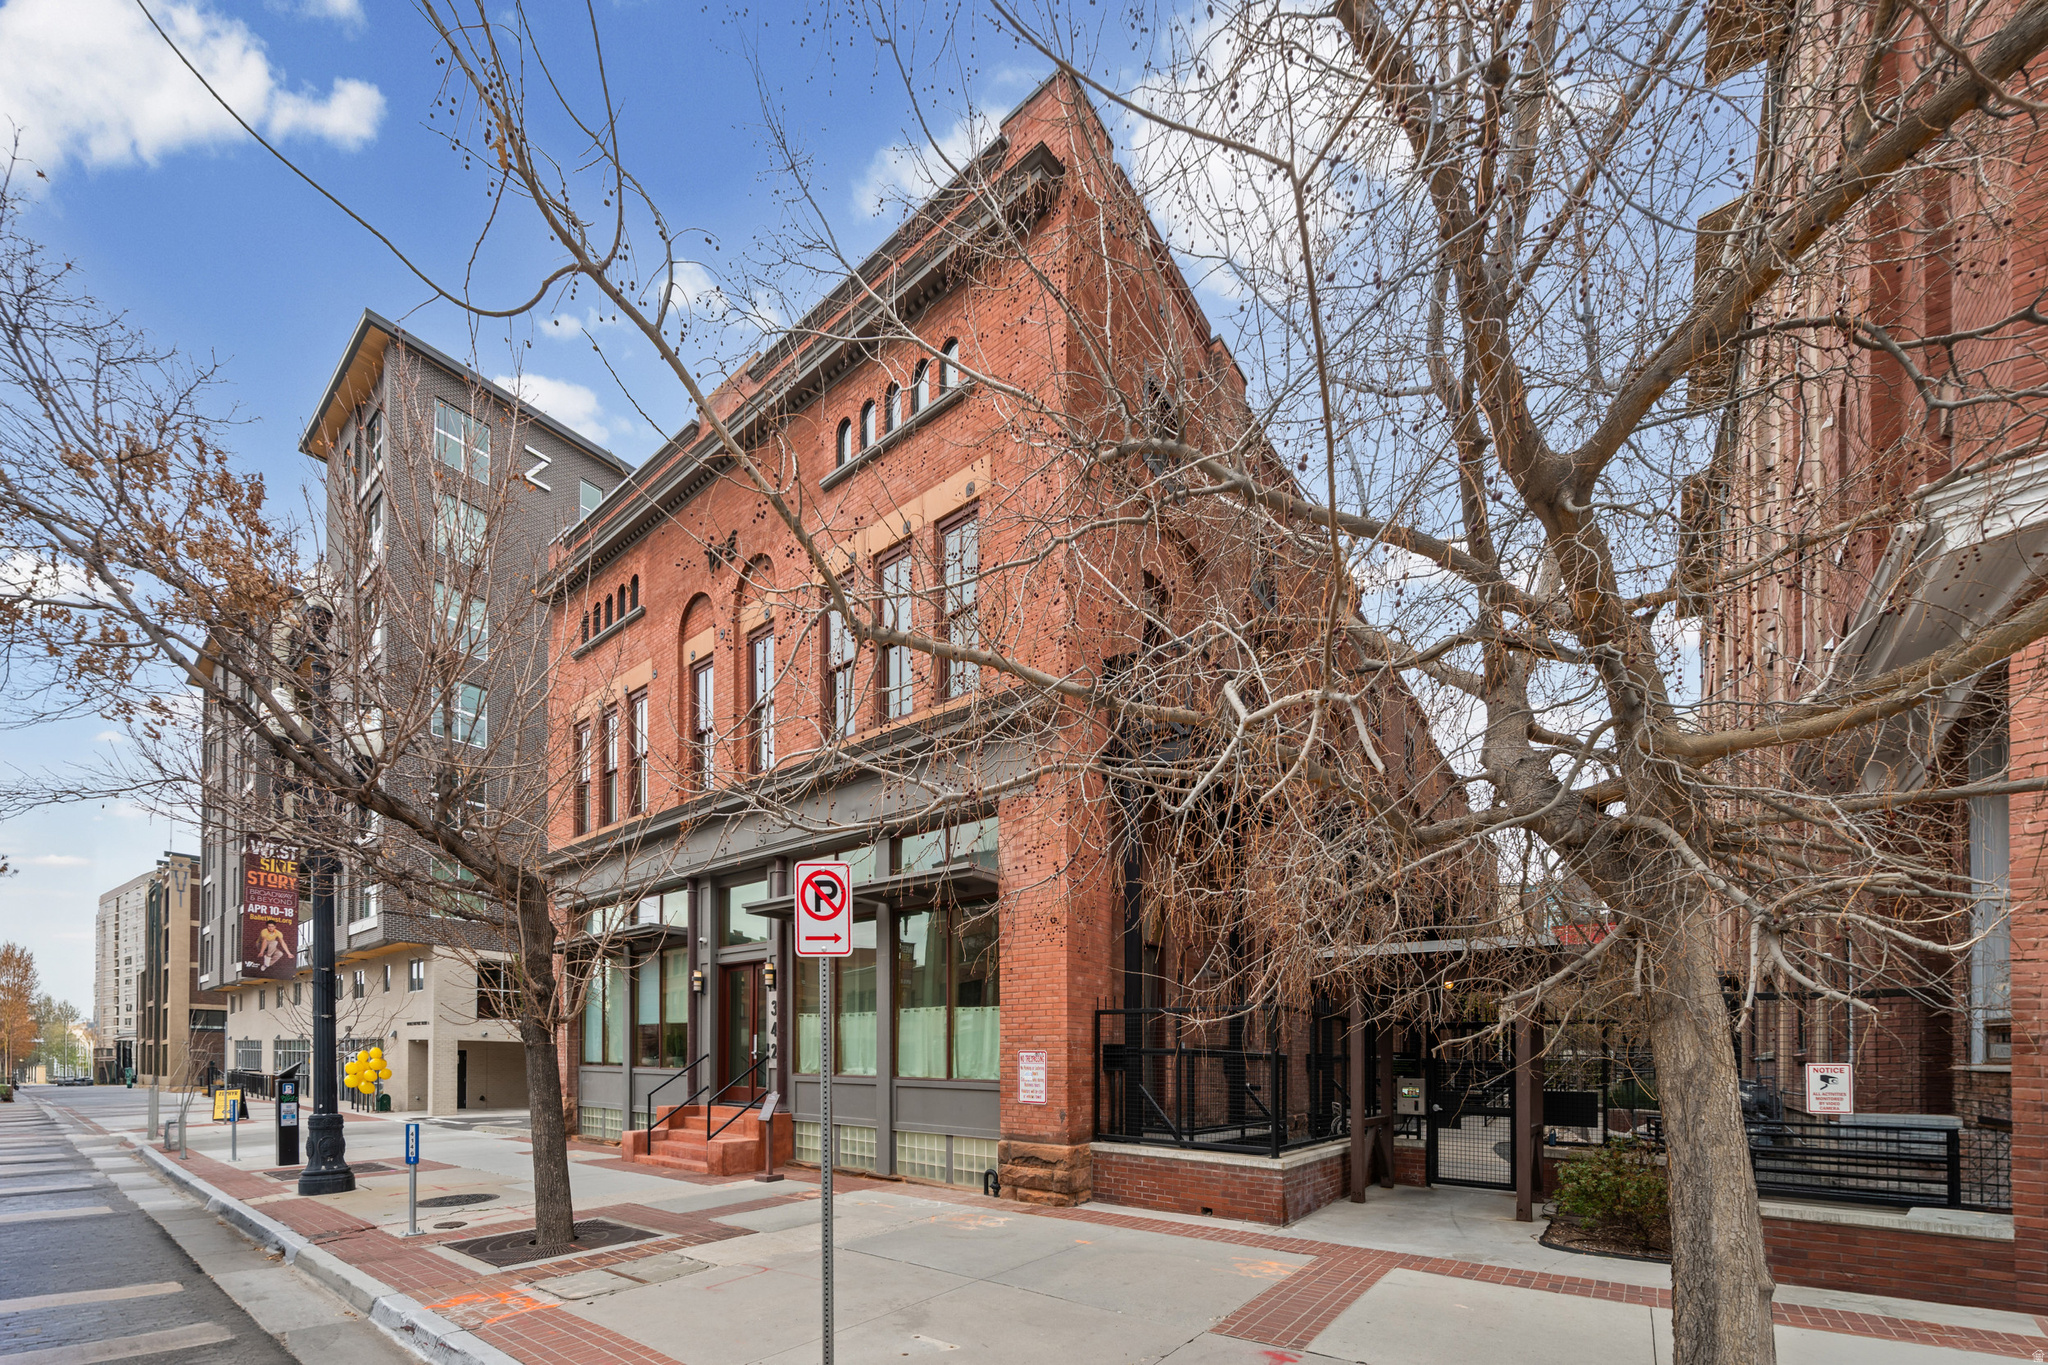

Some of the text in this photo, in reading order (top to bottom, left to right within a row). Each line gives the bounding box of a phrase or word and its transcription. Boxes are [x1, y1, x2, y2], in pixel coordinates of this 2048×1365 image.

[250, 840, 299, 860] WEST
[260, 858, 298, 873] SIDE
[247, 870, 297, 890] STORY
[249, 888, 293, 899] BROADWAY
[257, 895, 293, 905] BEYOND
[247, 903, 267, 914] APR
[249, 914, 293, 924] BalletWest.org
